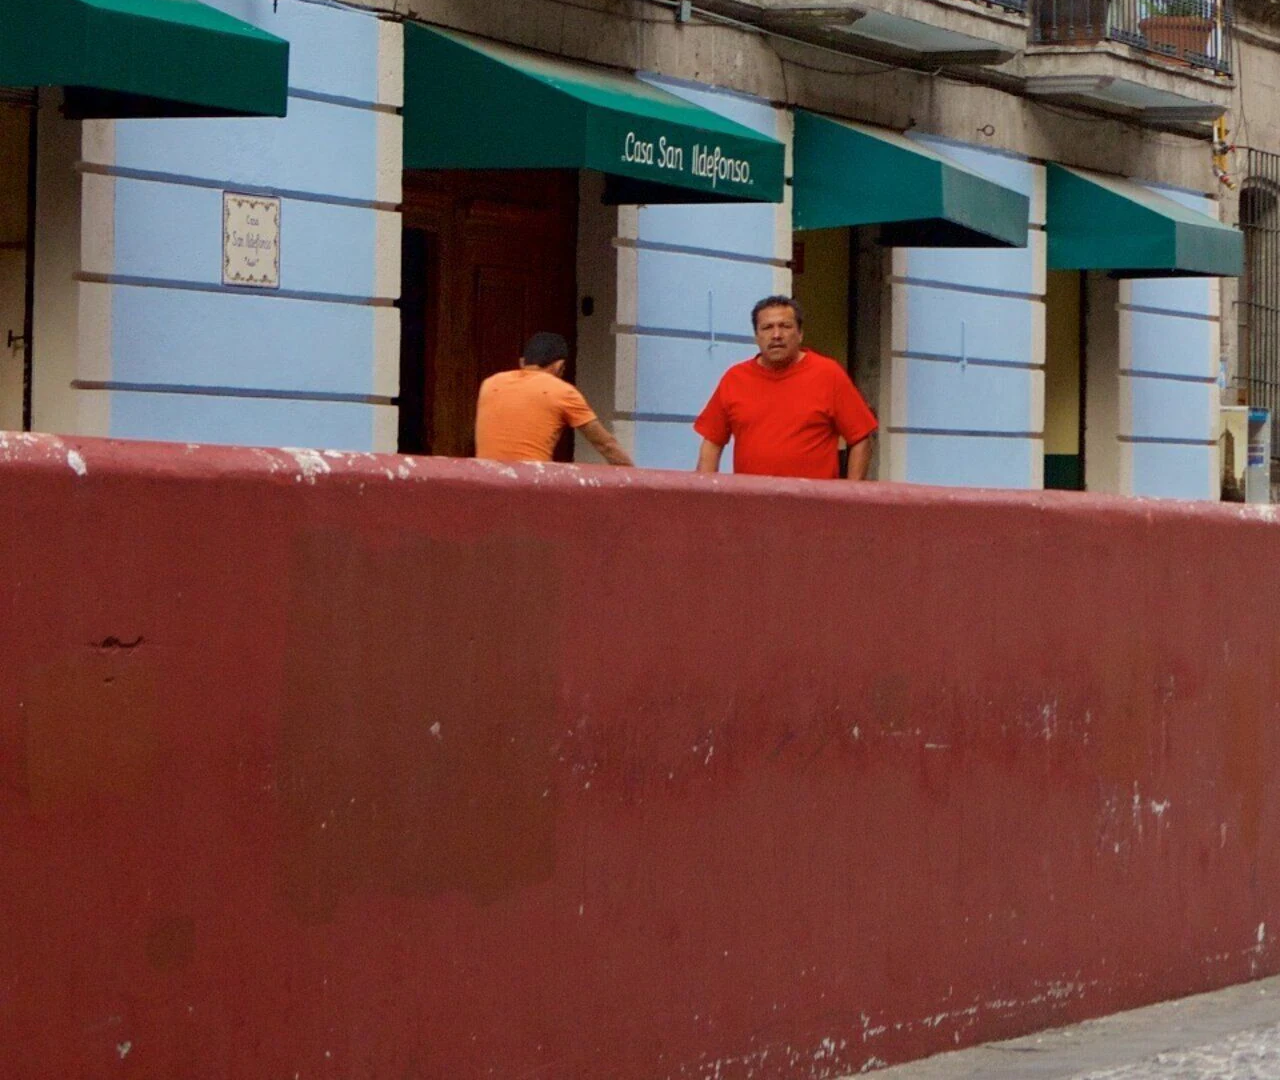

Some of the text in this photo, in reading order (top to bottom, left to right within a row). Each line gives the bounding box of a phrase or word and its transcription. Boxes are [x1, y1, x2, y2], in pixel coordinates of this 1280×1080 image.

[624, 131, 750, 188] Casa San Ildefonso
